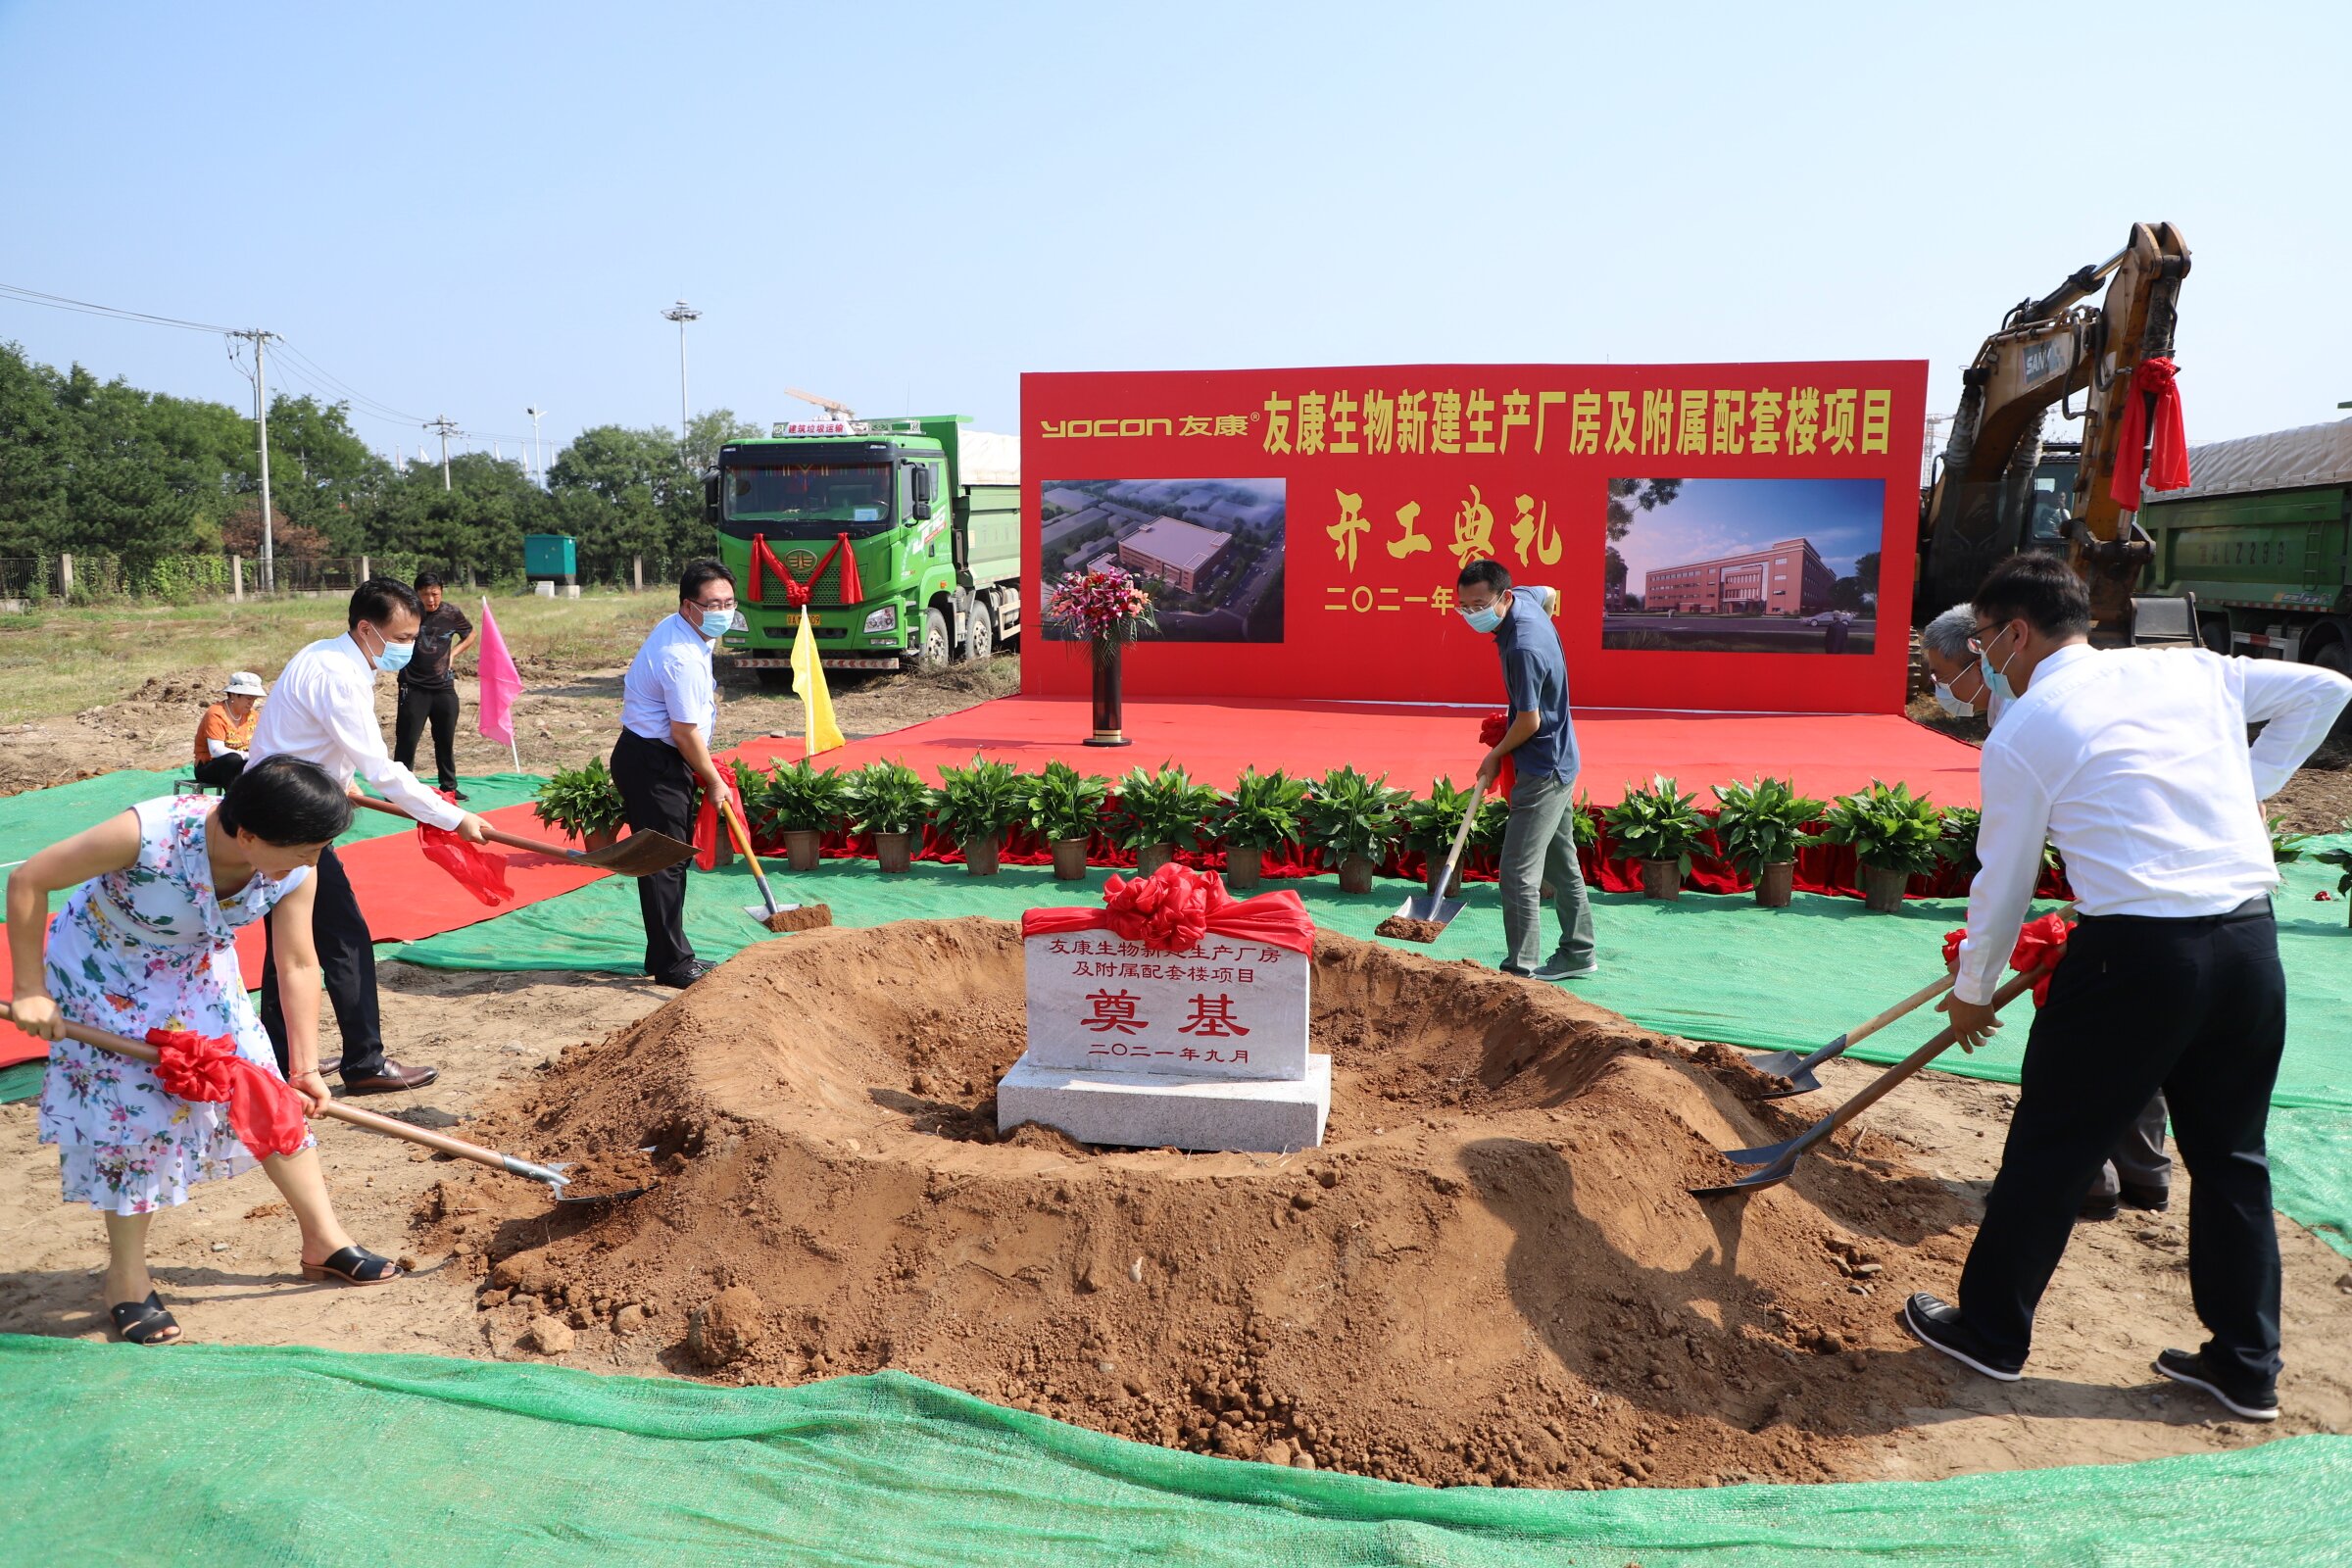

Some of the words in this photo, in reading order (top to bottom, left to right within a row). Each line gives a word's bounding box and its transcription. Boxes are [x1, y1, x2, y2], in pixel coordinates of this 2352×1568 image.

[787, 422, 845, 434] 建筑垃圾运输
[1262, 386, 1892, 457] 友康生物新建生产厂房及附属配套楼项目
[1325, 483, 1563, 575] 开工典礼
[1071, 960, 1255, 984] 及附属配套楼项目
